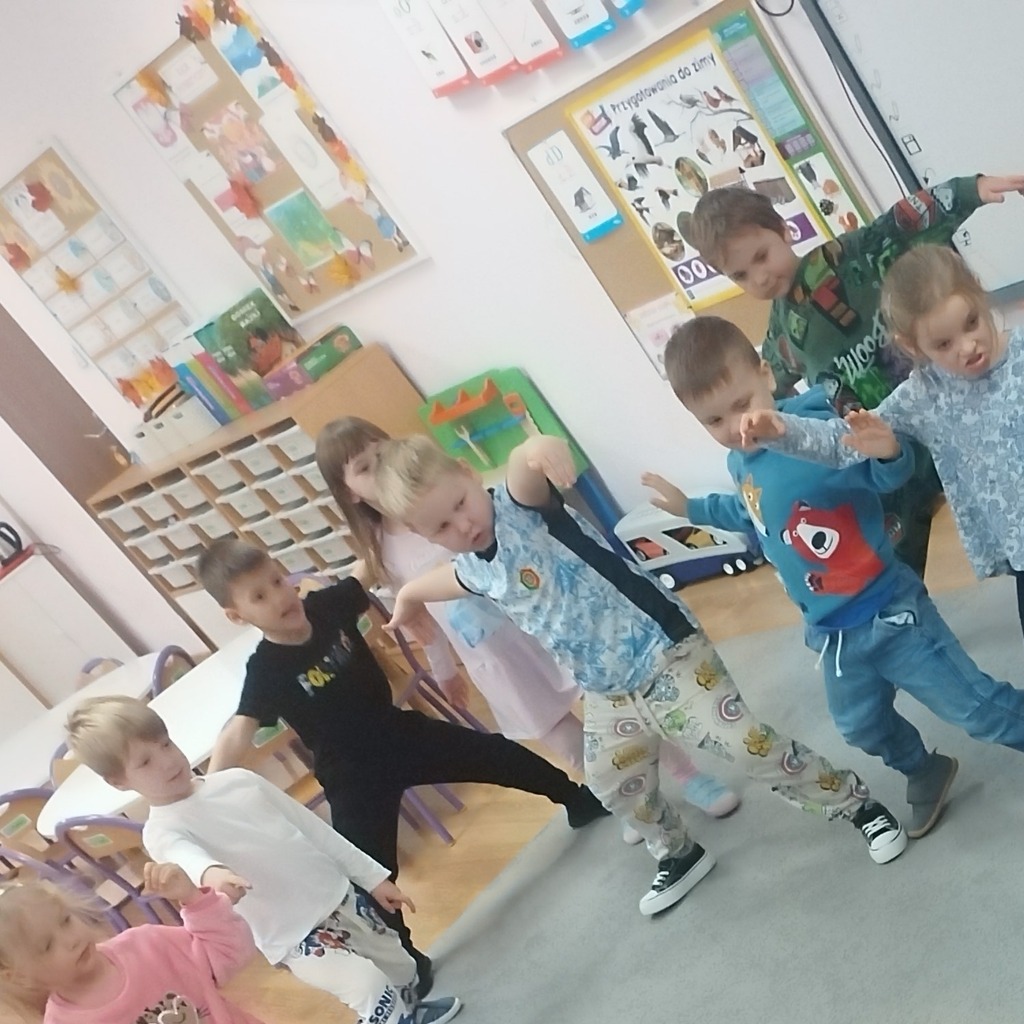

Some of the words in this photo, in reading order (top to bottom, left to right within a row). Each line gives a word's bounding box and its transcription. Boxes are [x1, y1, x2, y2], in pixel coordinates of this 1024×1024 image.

[610, 74, 678, 114] Przygotowania
[677, 66, 692, 80] do
[693, 52, 717, 73] zimy
